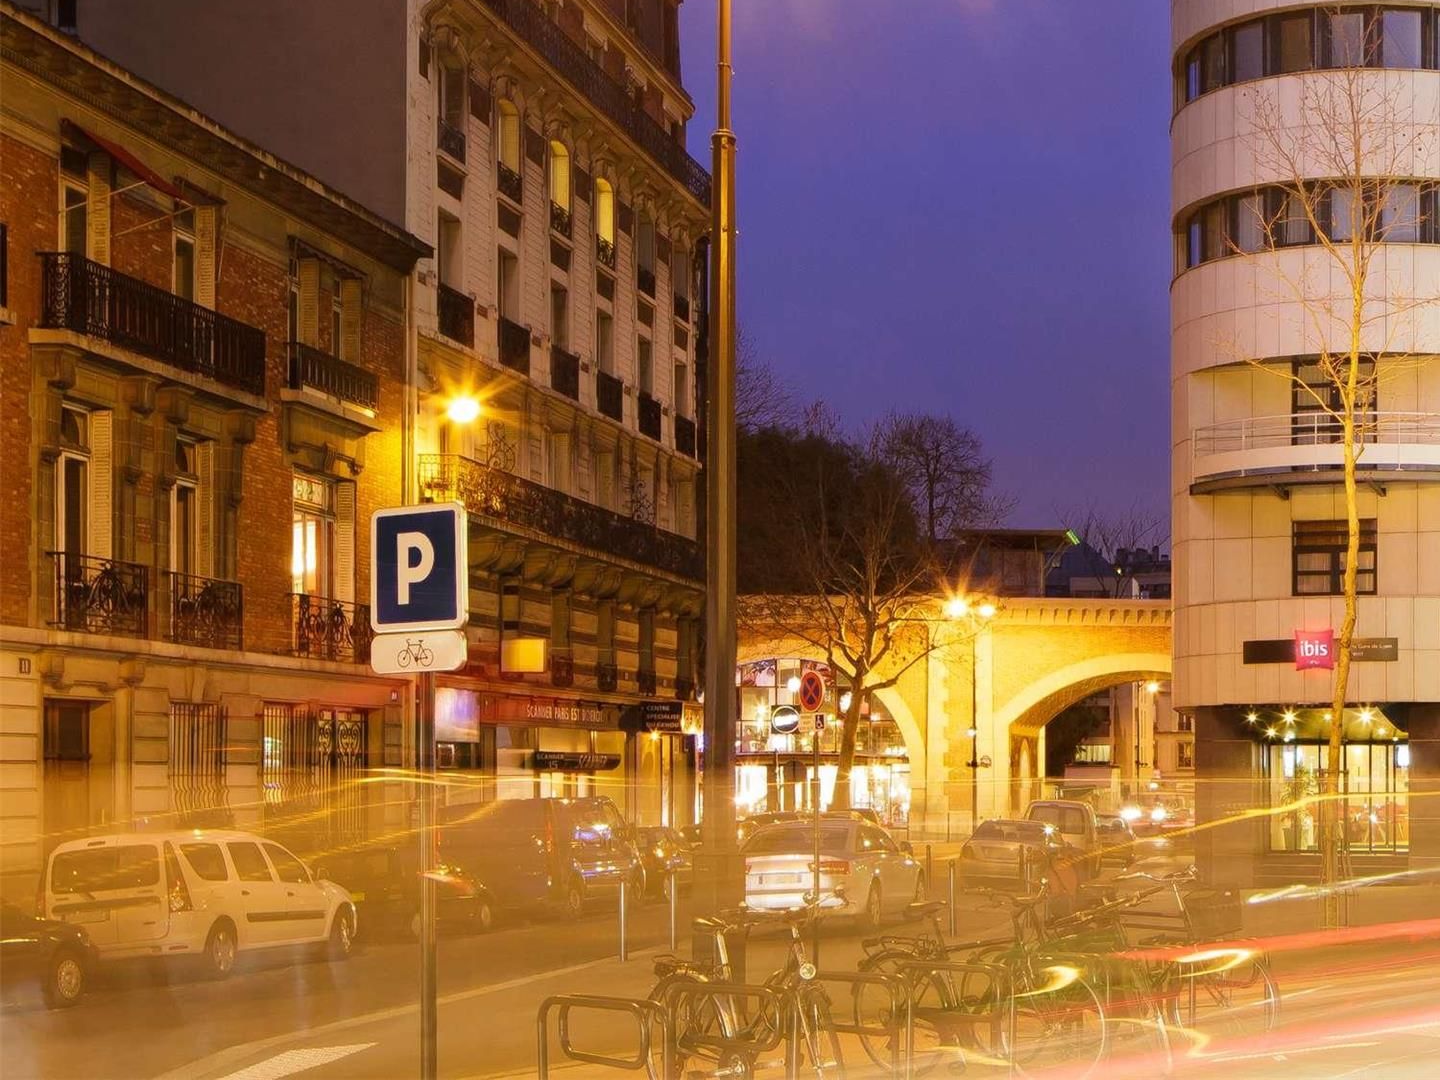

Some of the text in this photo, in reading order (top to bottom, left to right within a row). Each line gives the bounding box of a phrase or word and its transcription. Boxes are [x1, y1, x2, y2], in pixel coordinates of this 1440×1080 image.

[397, 531, 434, 605] P
[1300, 640, 1328, 656] ibis
[526, 704, 552, 719] SCANNER
